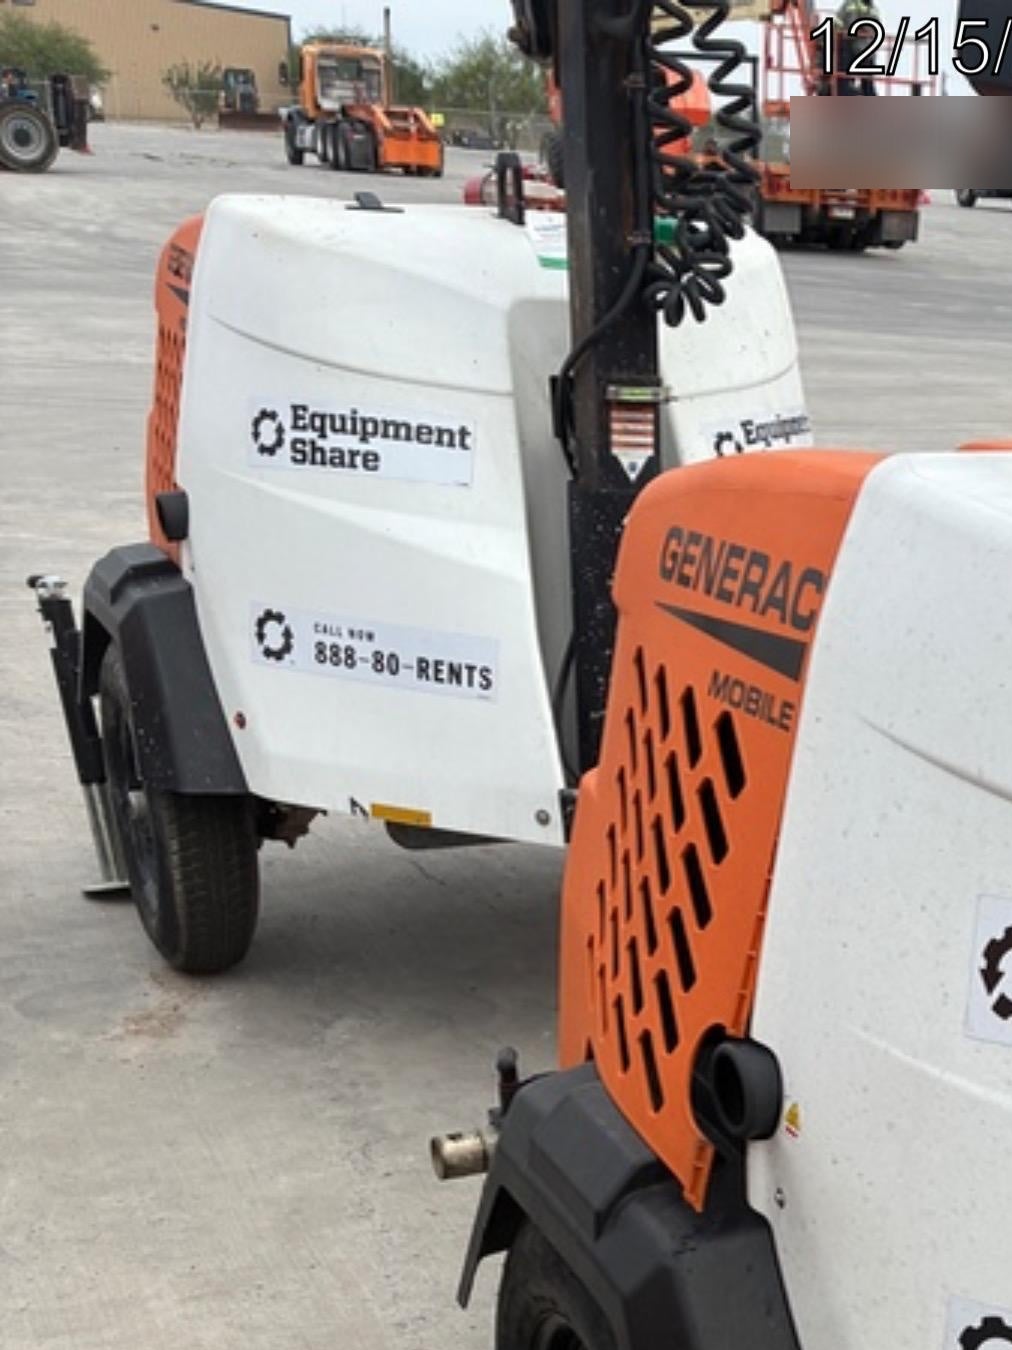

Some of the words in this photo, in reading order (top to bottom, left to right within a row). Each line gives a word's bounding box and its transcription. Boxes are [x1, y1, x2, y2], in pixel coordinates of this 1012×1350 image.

[290, 404, 472, 451] Equipment
[290, 438, 381, 472] Share
[659, 525, 826, 632] GENERAC
[314, 622, 343, 638] CALL
[348, 628, 375, 643] NOW
[314, 641, 494, 691] 888-80-RENTS
[708, 668, 796, 733] MOBILE
